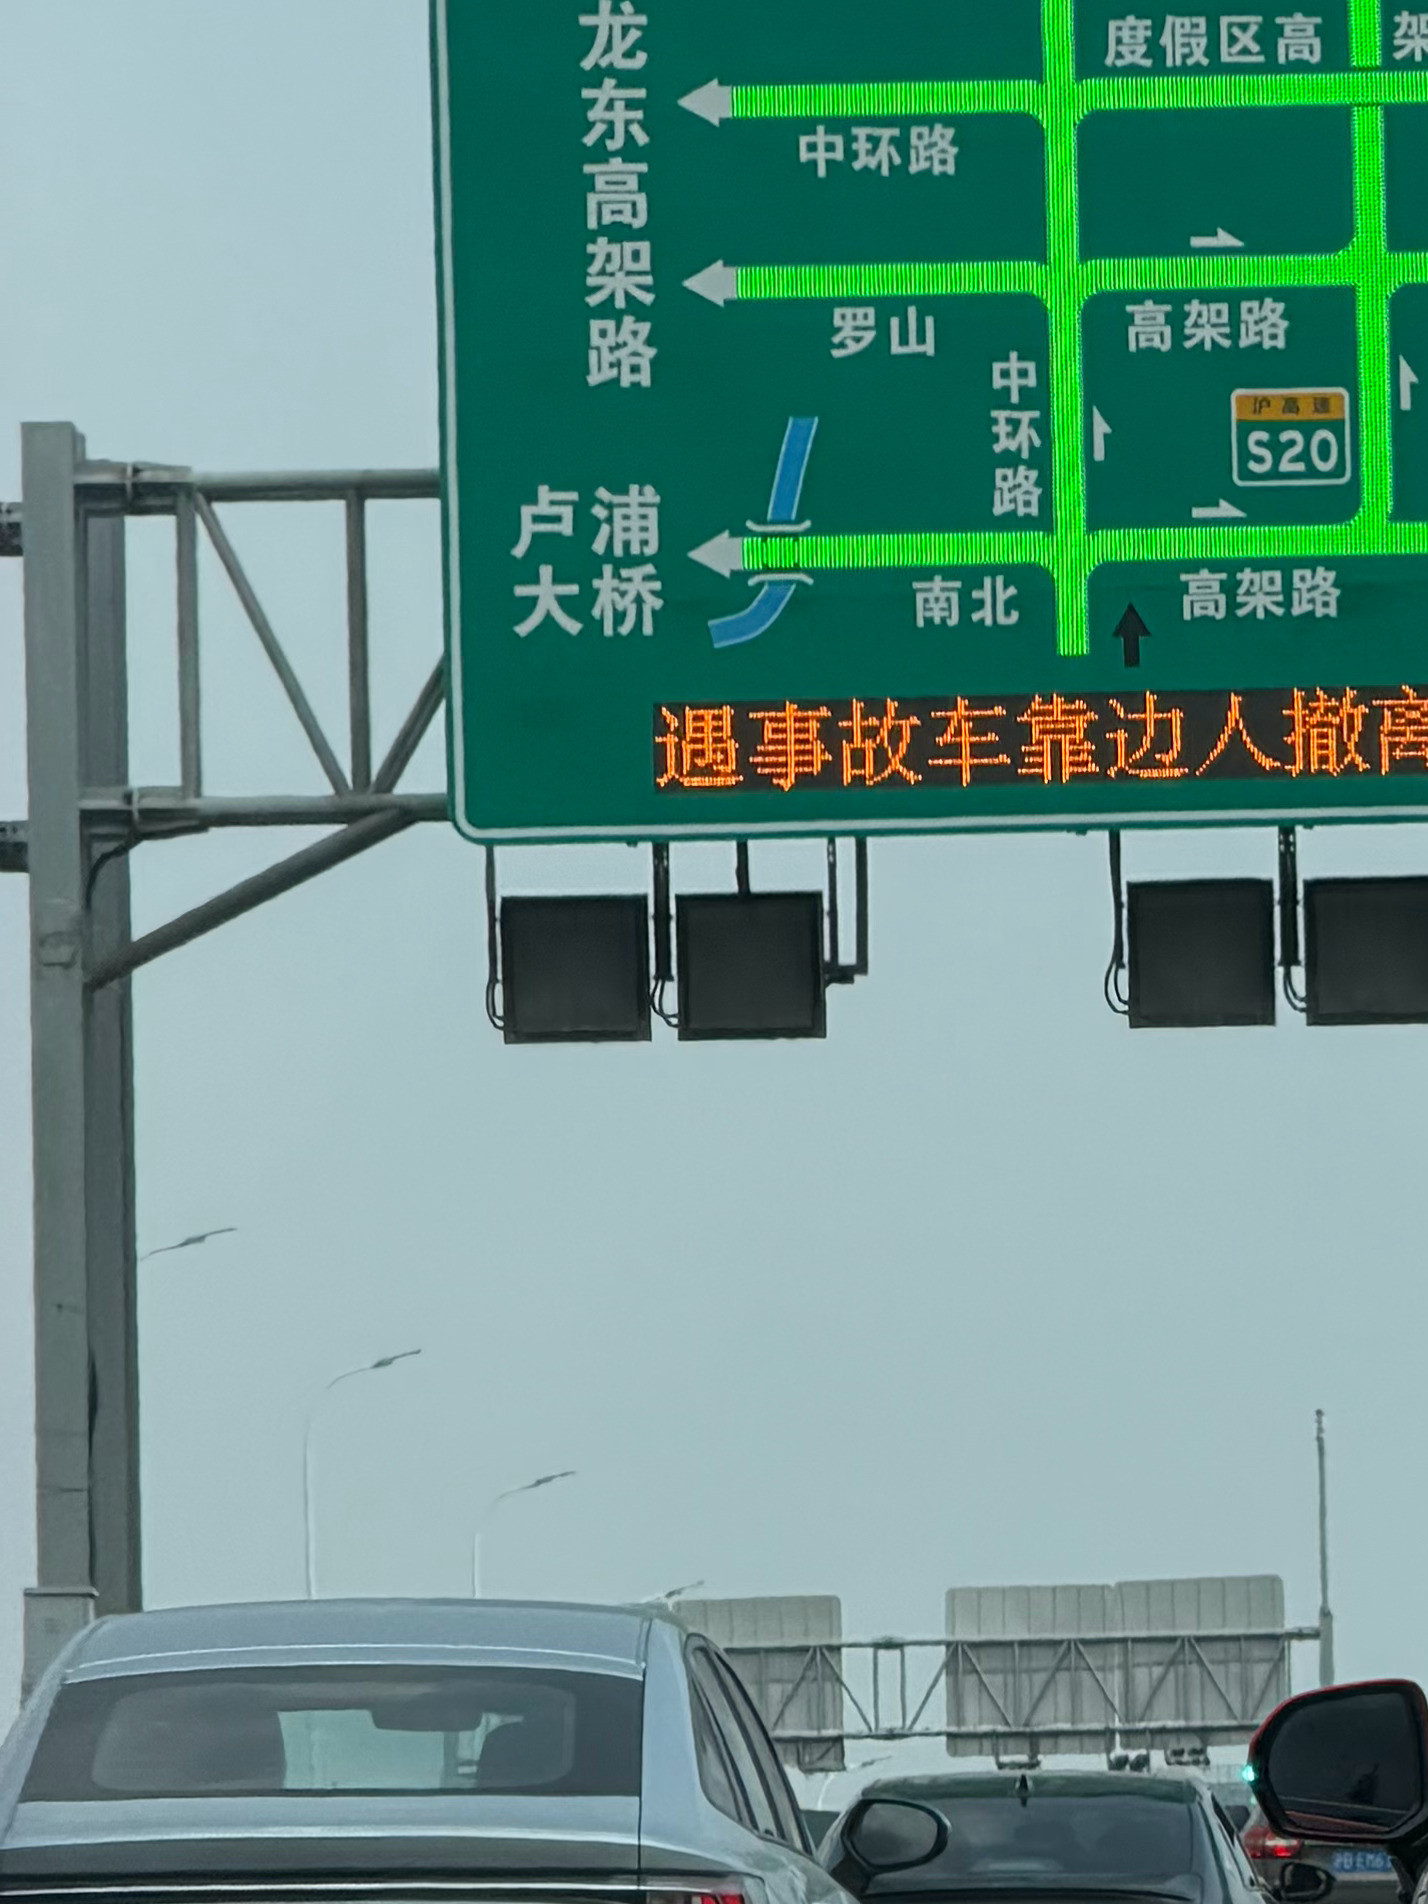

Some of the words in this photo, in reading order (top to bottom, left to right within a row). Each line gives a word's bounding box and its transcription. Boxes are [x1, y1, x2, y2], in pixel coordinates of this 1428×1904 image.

[799, 123, 959, 178] 中环路
[830, 305, 935, 358] 罗山
[1125, 297, 1289, 352] 高架路
[990, 351, 1043, 516] 中环路
[1252, 396, 1331, 416] 沪高速
[1247, 430, 1339, 473] S20
[511, 484, 661, 558] 卢浦
[513, 563, 664, 637] 大桥
[912, 575, 1019, 627] 南北
[1180, 567, 1341, 621] 高架路
